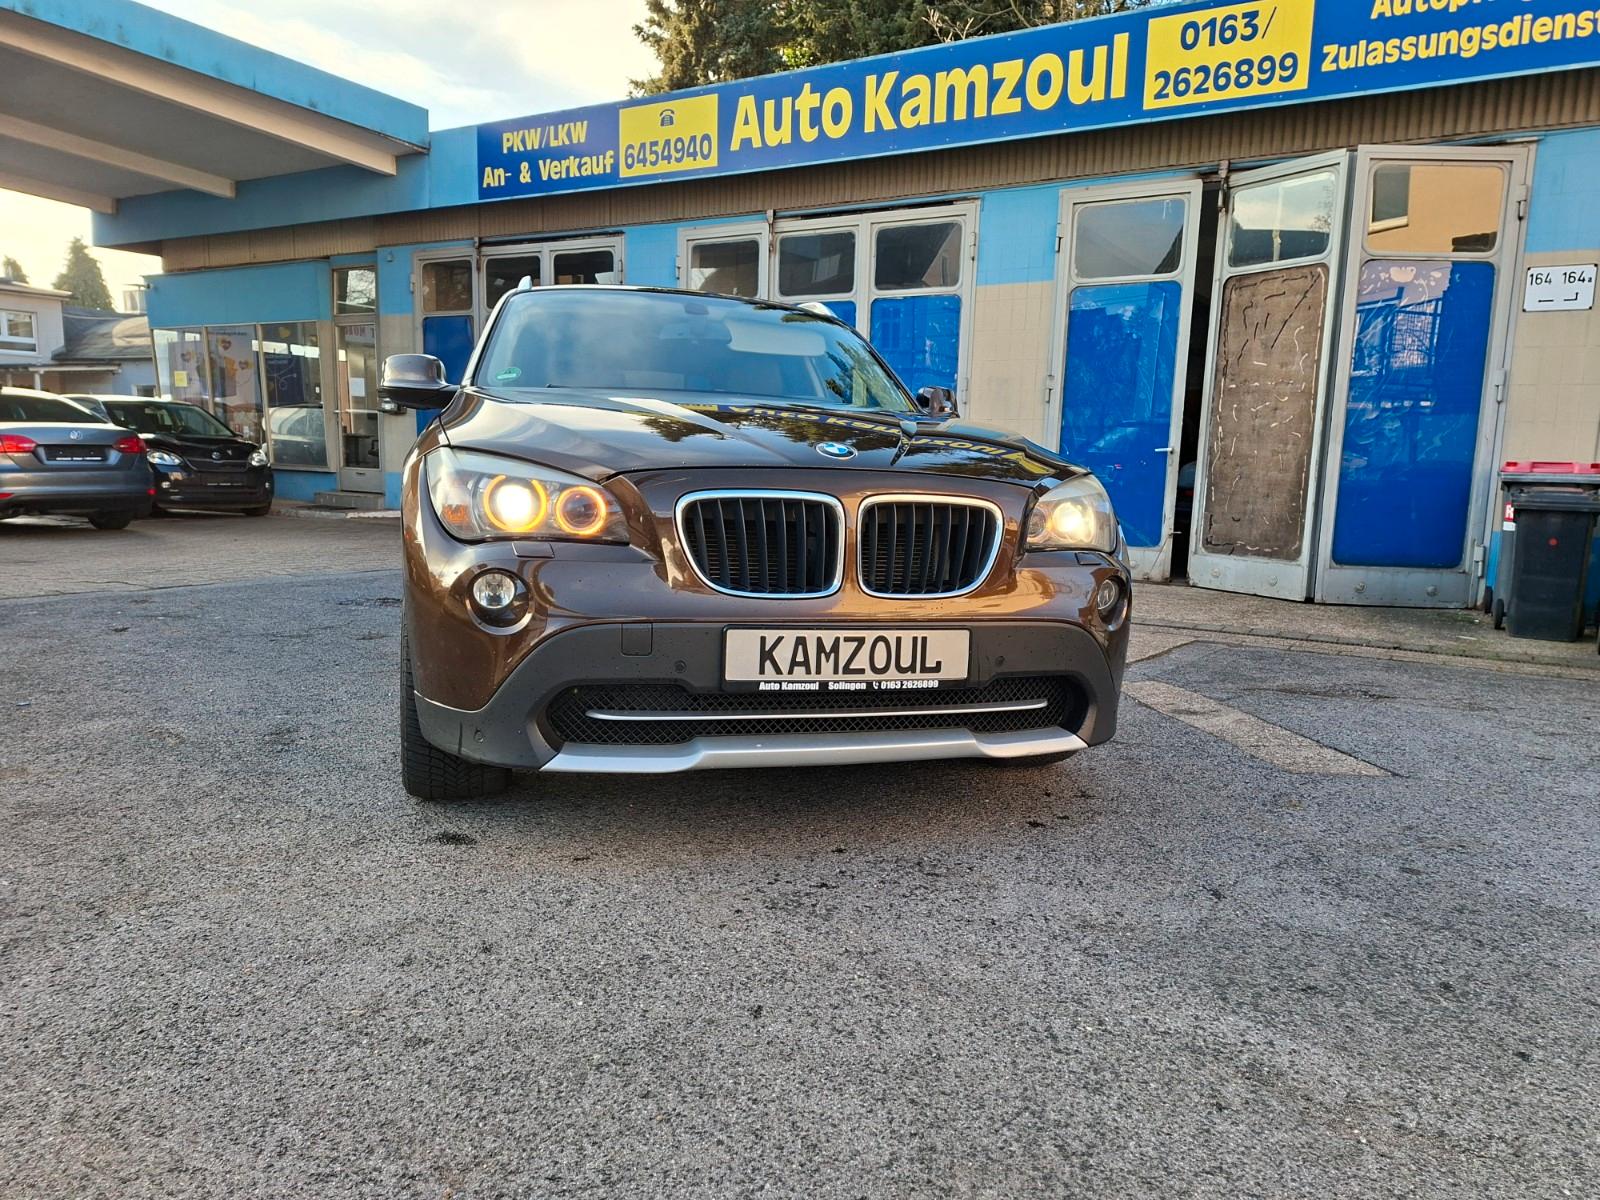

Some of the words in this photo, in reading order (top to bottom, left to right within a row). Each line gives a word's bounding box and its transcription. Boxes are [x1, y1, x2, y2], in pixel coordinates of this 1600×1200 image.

[1179, 7, 1276, 51] 0163/
[730, 82, 853, 151] Auto
[863, 32, 1130, 133] Kamzoul
[1153, 52, 1299, 101] 2626899
[502, 120, 588, 154] PKW/LKW
[623, 133, 713, 170] 6454940
[482, 167, 512, 189] An-
[519, 161, 531, 184] &
[537, 150, 614, 182] Verkauf
[1529, 272, 1552, 286] 164
[758, 635, 942, 676] KAMZOUL
[759, 682, 780, 691] Auto
[781, 681, 820, 691] Kamzoul
[828, 681, 867, 691] Solingen
[880, 681, 901, 689] 0163
